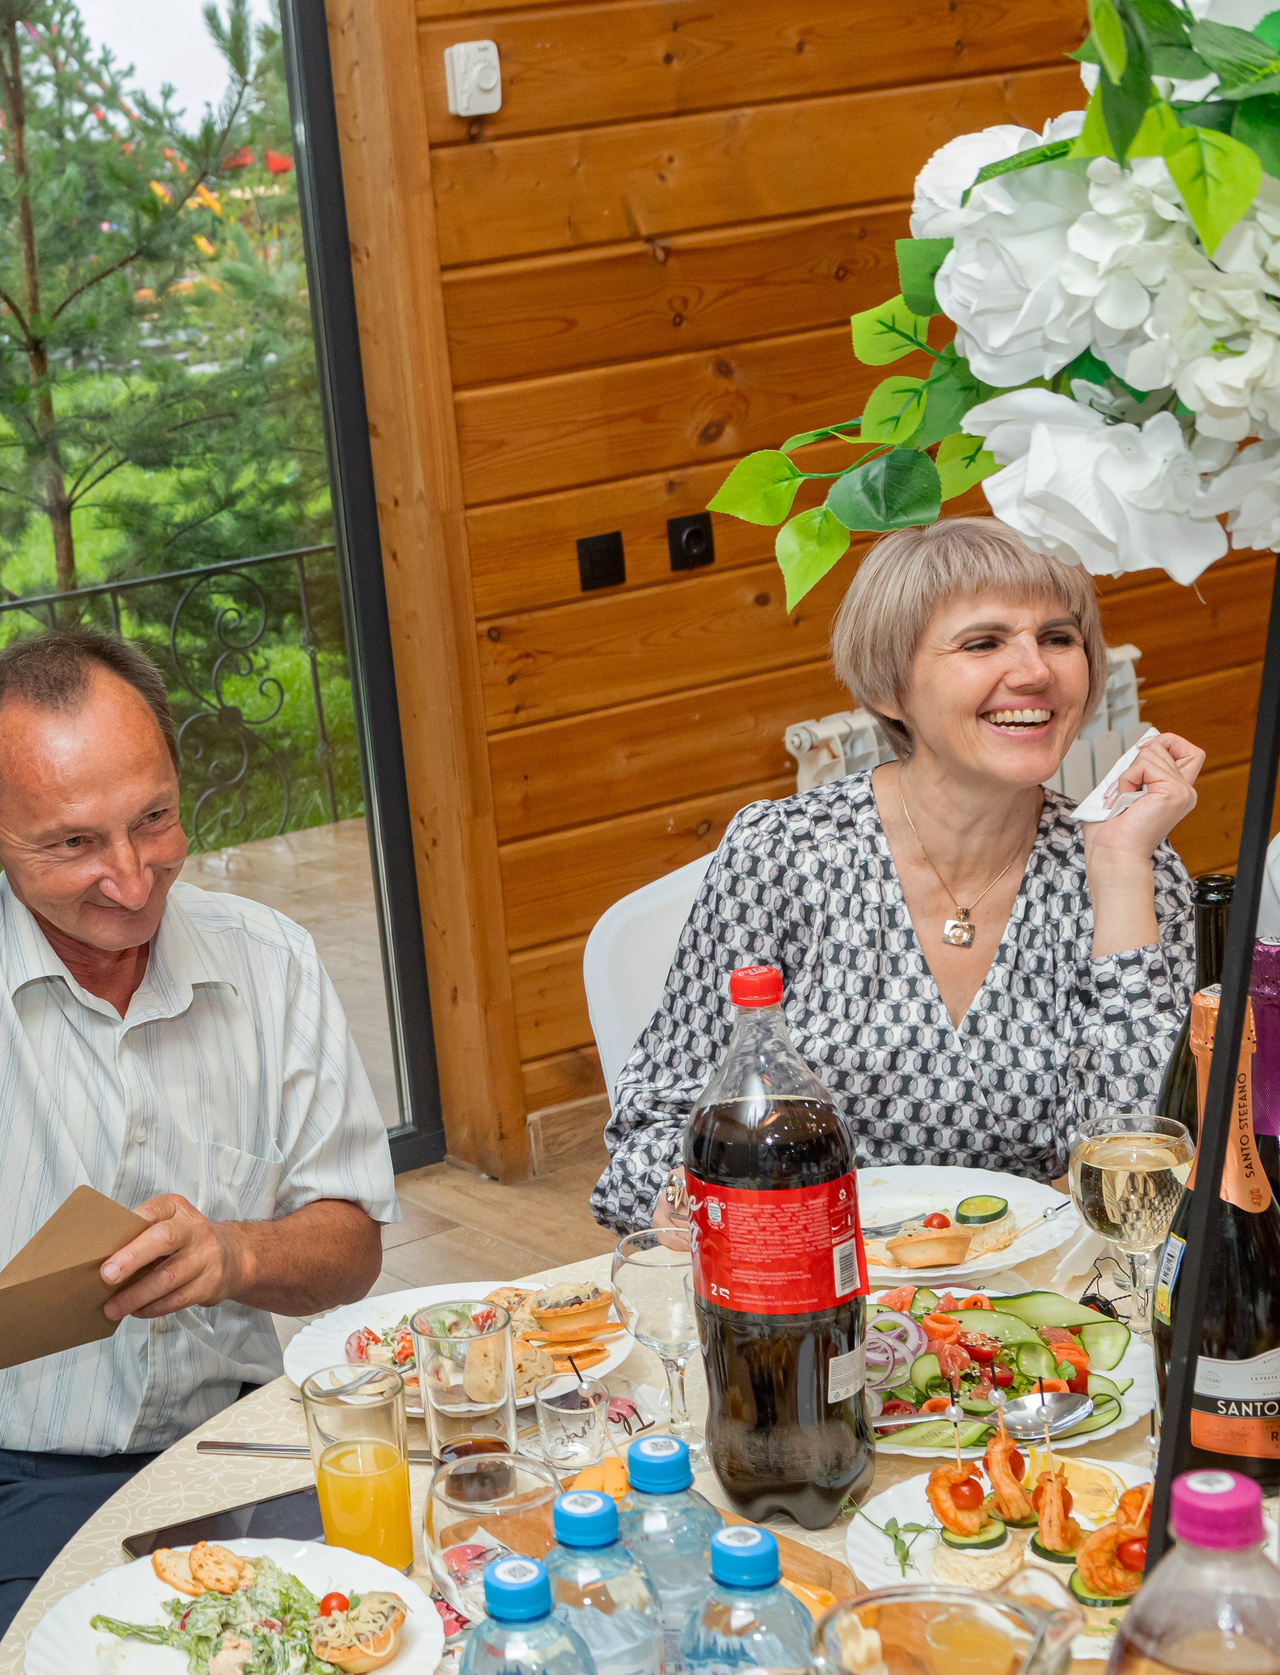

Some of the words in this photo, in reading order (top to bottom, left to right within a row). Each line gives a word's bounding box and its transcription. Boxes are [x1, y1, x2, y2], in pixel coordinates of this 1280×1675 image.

[1237, 1072, 1248, 1131] STEFANO
[1240, 1134, 1256, 1179] SANTO
[710, 1282, 718, 1296] 2
[1217, 1400, 1279, 1416] SANTO
